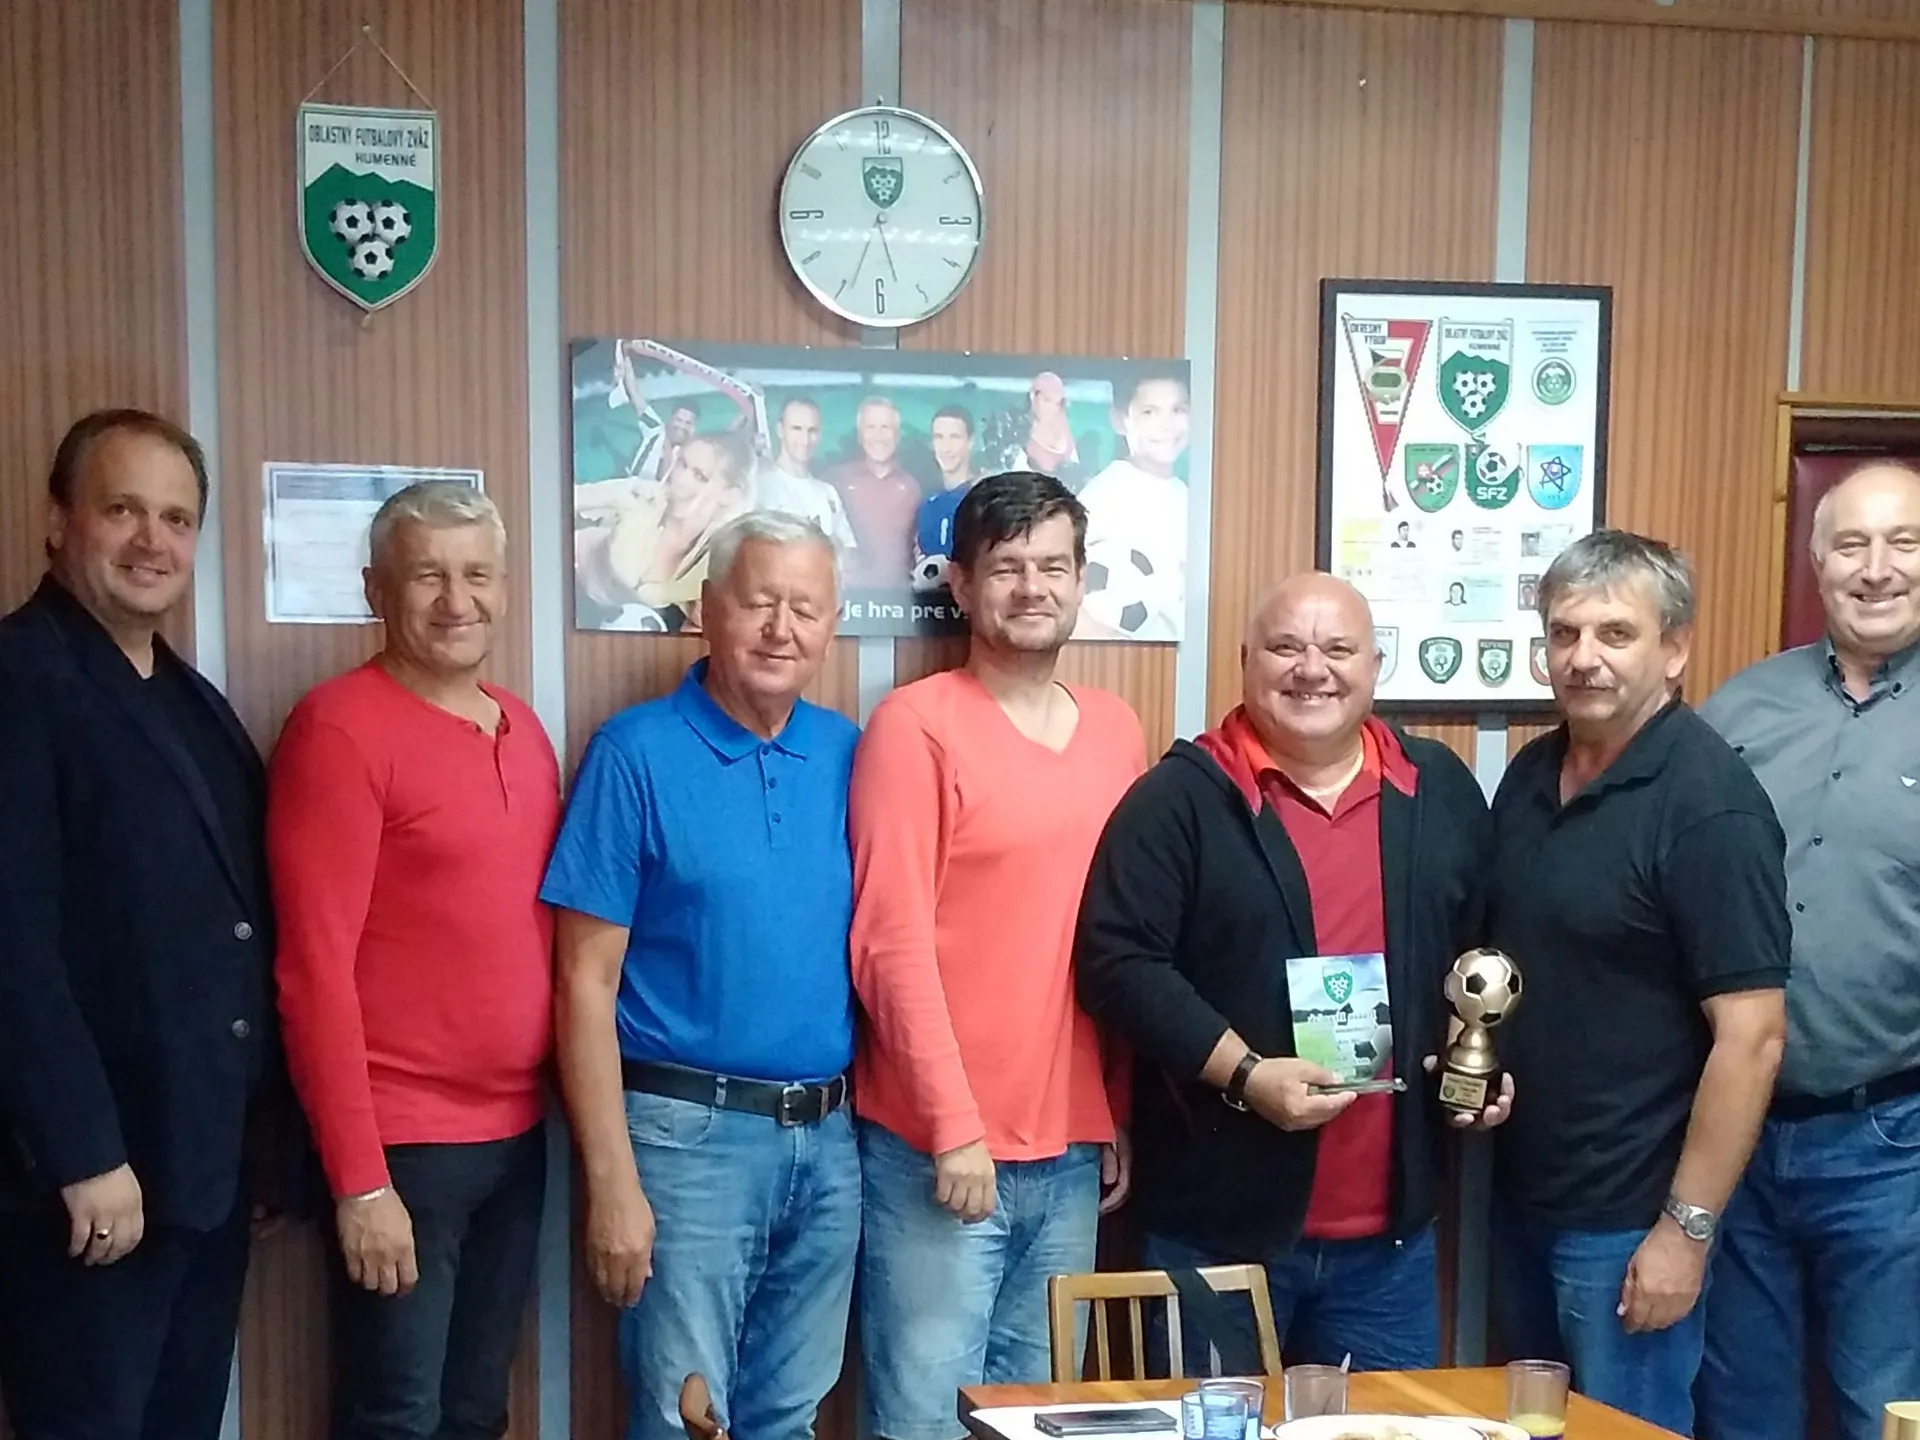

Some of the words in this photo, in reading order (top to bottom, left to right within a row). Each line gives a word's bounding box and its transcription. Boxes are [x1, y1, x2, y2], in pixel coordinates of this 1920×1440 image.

[873, 120, 890, 155] 12
[789, 209, 824, 220] 9
[938, 216, 972, 226] 3
[875, 278, 885, 315] 6
[1477, 487, 1508, 500] SFZ
[843, 600, 862, 621] je
[868, 601, 904, 618] hra
[911, 605, 945, 622] pre
